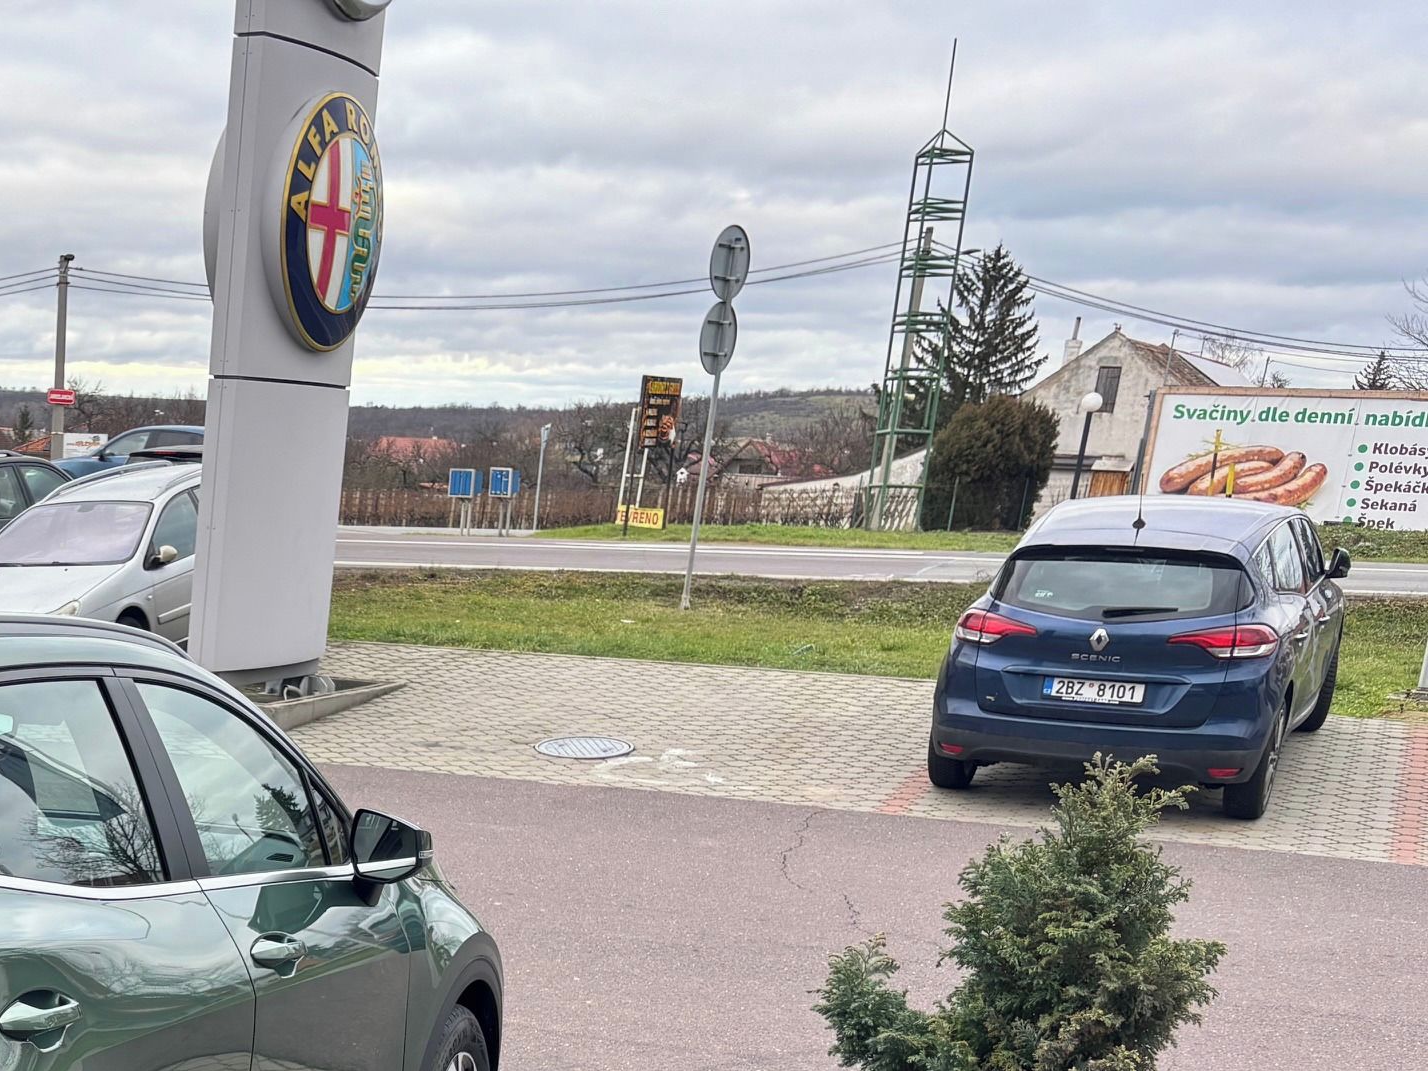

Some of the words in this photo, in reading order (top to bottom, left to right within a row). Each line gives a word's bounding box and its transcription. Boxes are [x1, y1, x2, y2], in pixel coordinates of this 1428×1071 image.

[290, 107, 341, 224] ALFA
[1172, 403, 1252, 425] Svačiny
[1257, 406, 1290, 423] dle
[1294, 407, 1355, 425] denní
[1368, 461, 1428, 478] Polévky
[1364, 476, 1428, 495] Špekáčk
[1360, 497, 1417, 512] Sekaná
[1357, 513, 1395, 530] Špek
[1071, 653, 1121, 663] SCENIC
[1055, 680, 1086, 696] 2BZ
[1096, 683, 1137, 700] 8101
